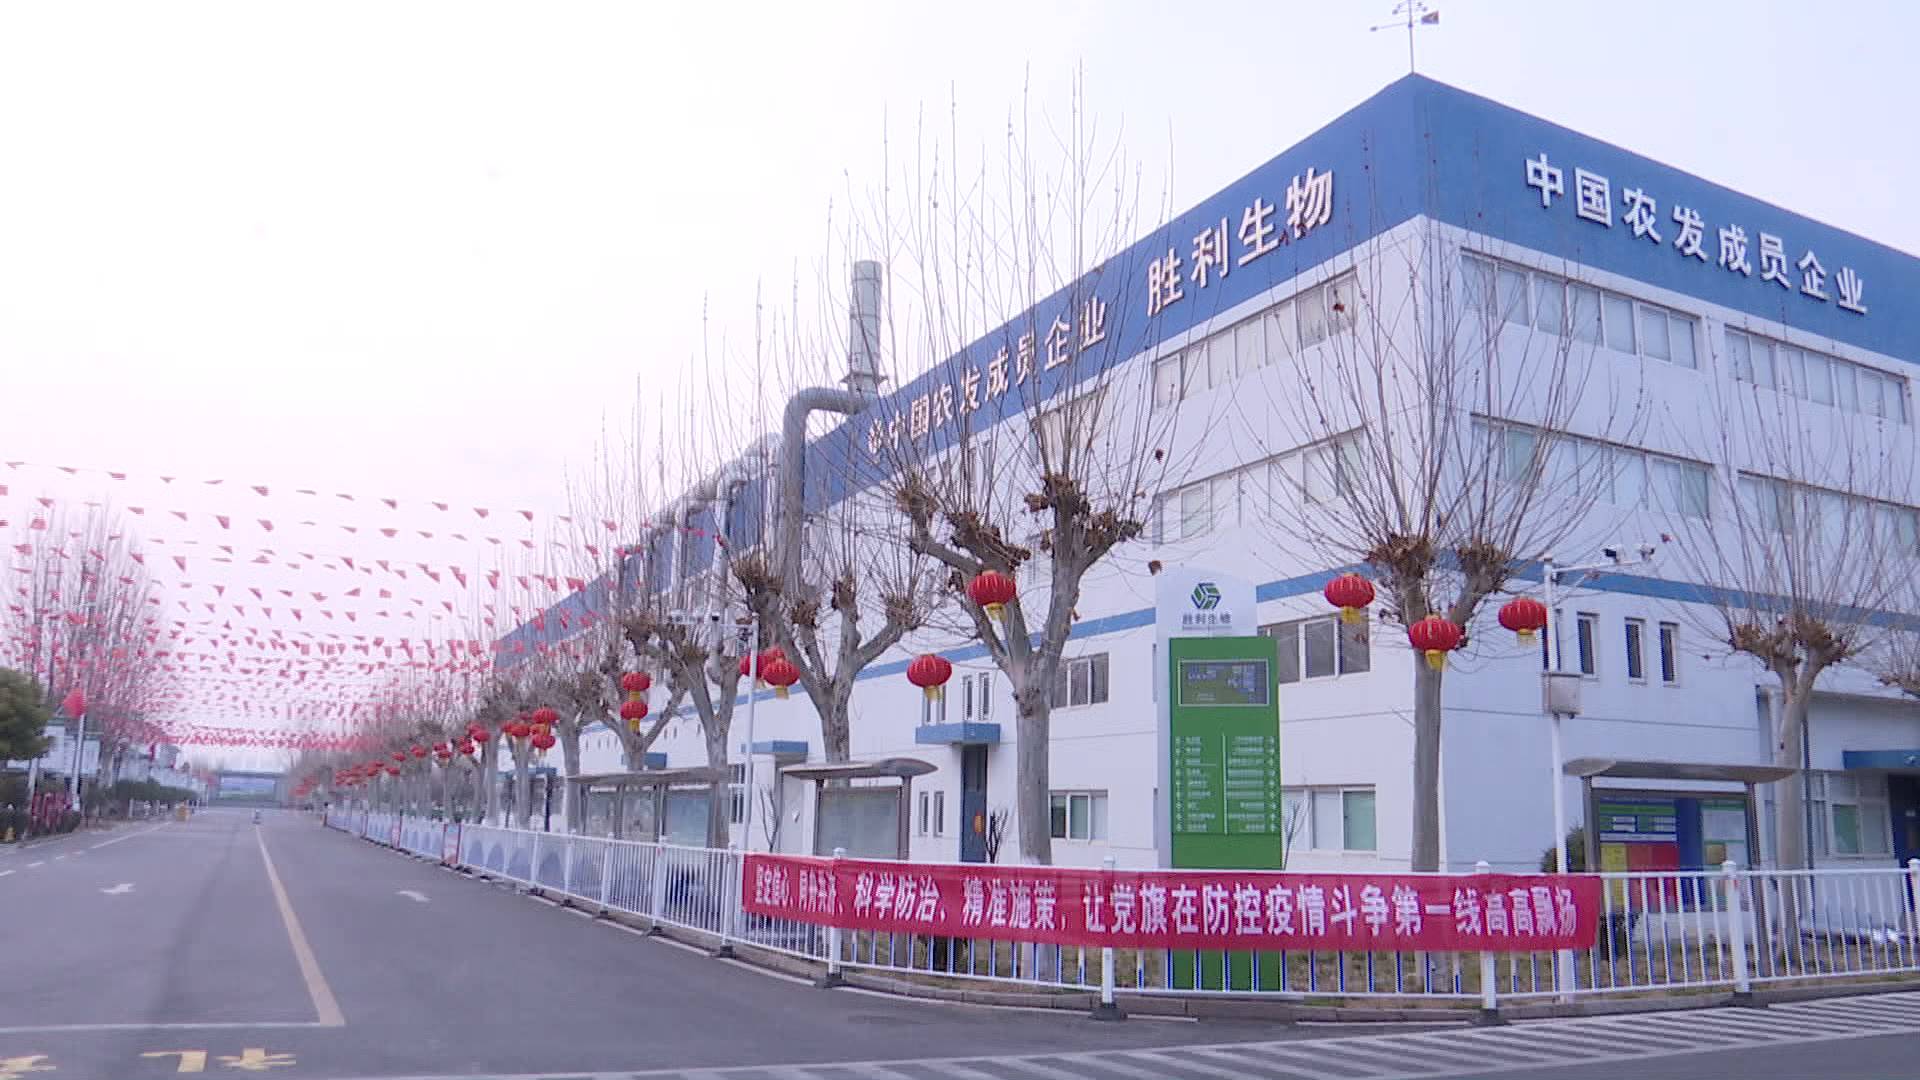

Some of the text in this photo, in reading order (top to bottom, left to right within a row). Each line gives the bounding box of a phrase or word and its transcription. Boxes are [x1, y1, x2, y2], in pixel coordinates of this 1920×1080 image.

[1146, 166, 1335, 316] 胜利生物
[1525, 152, 1868, 315] 中国农发成员企业
